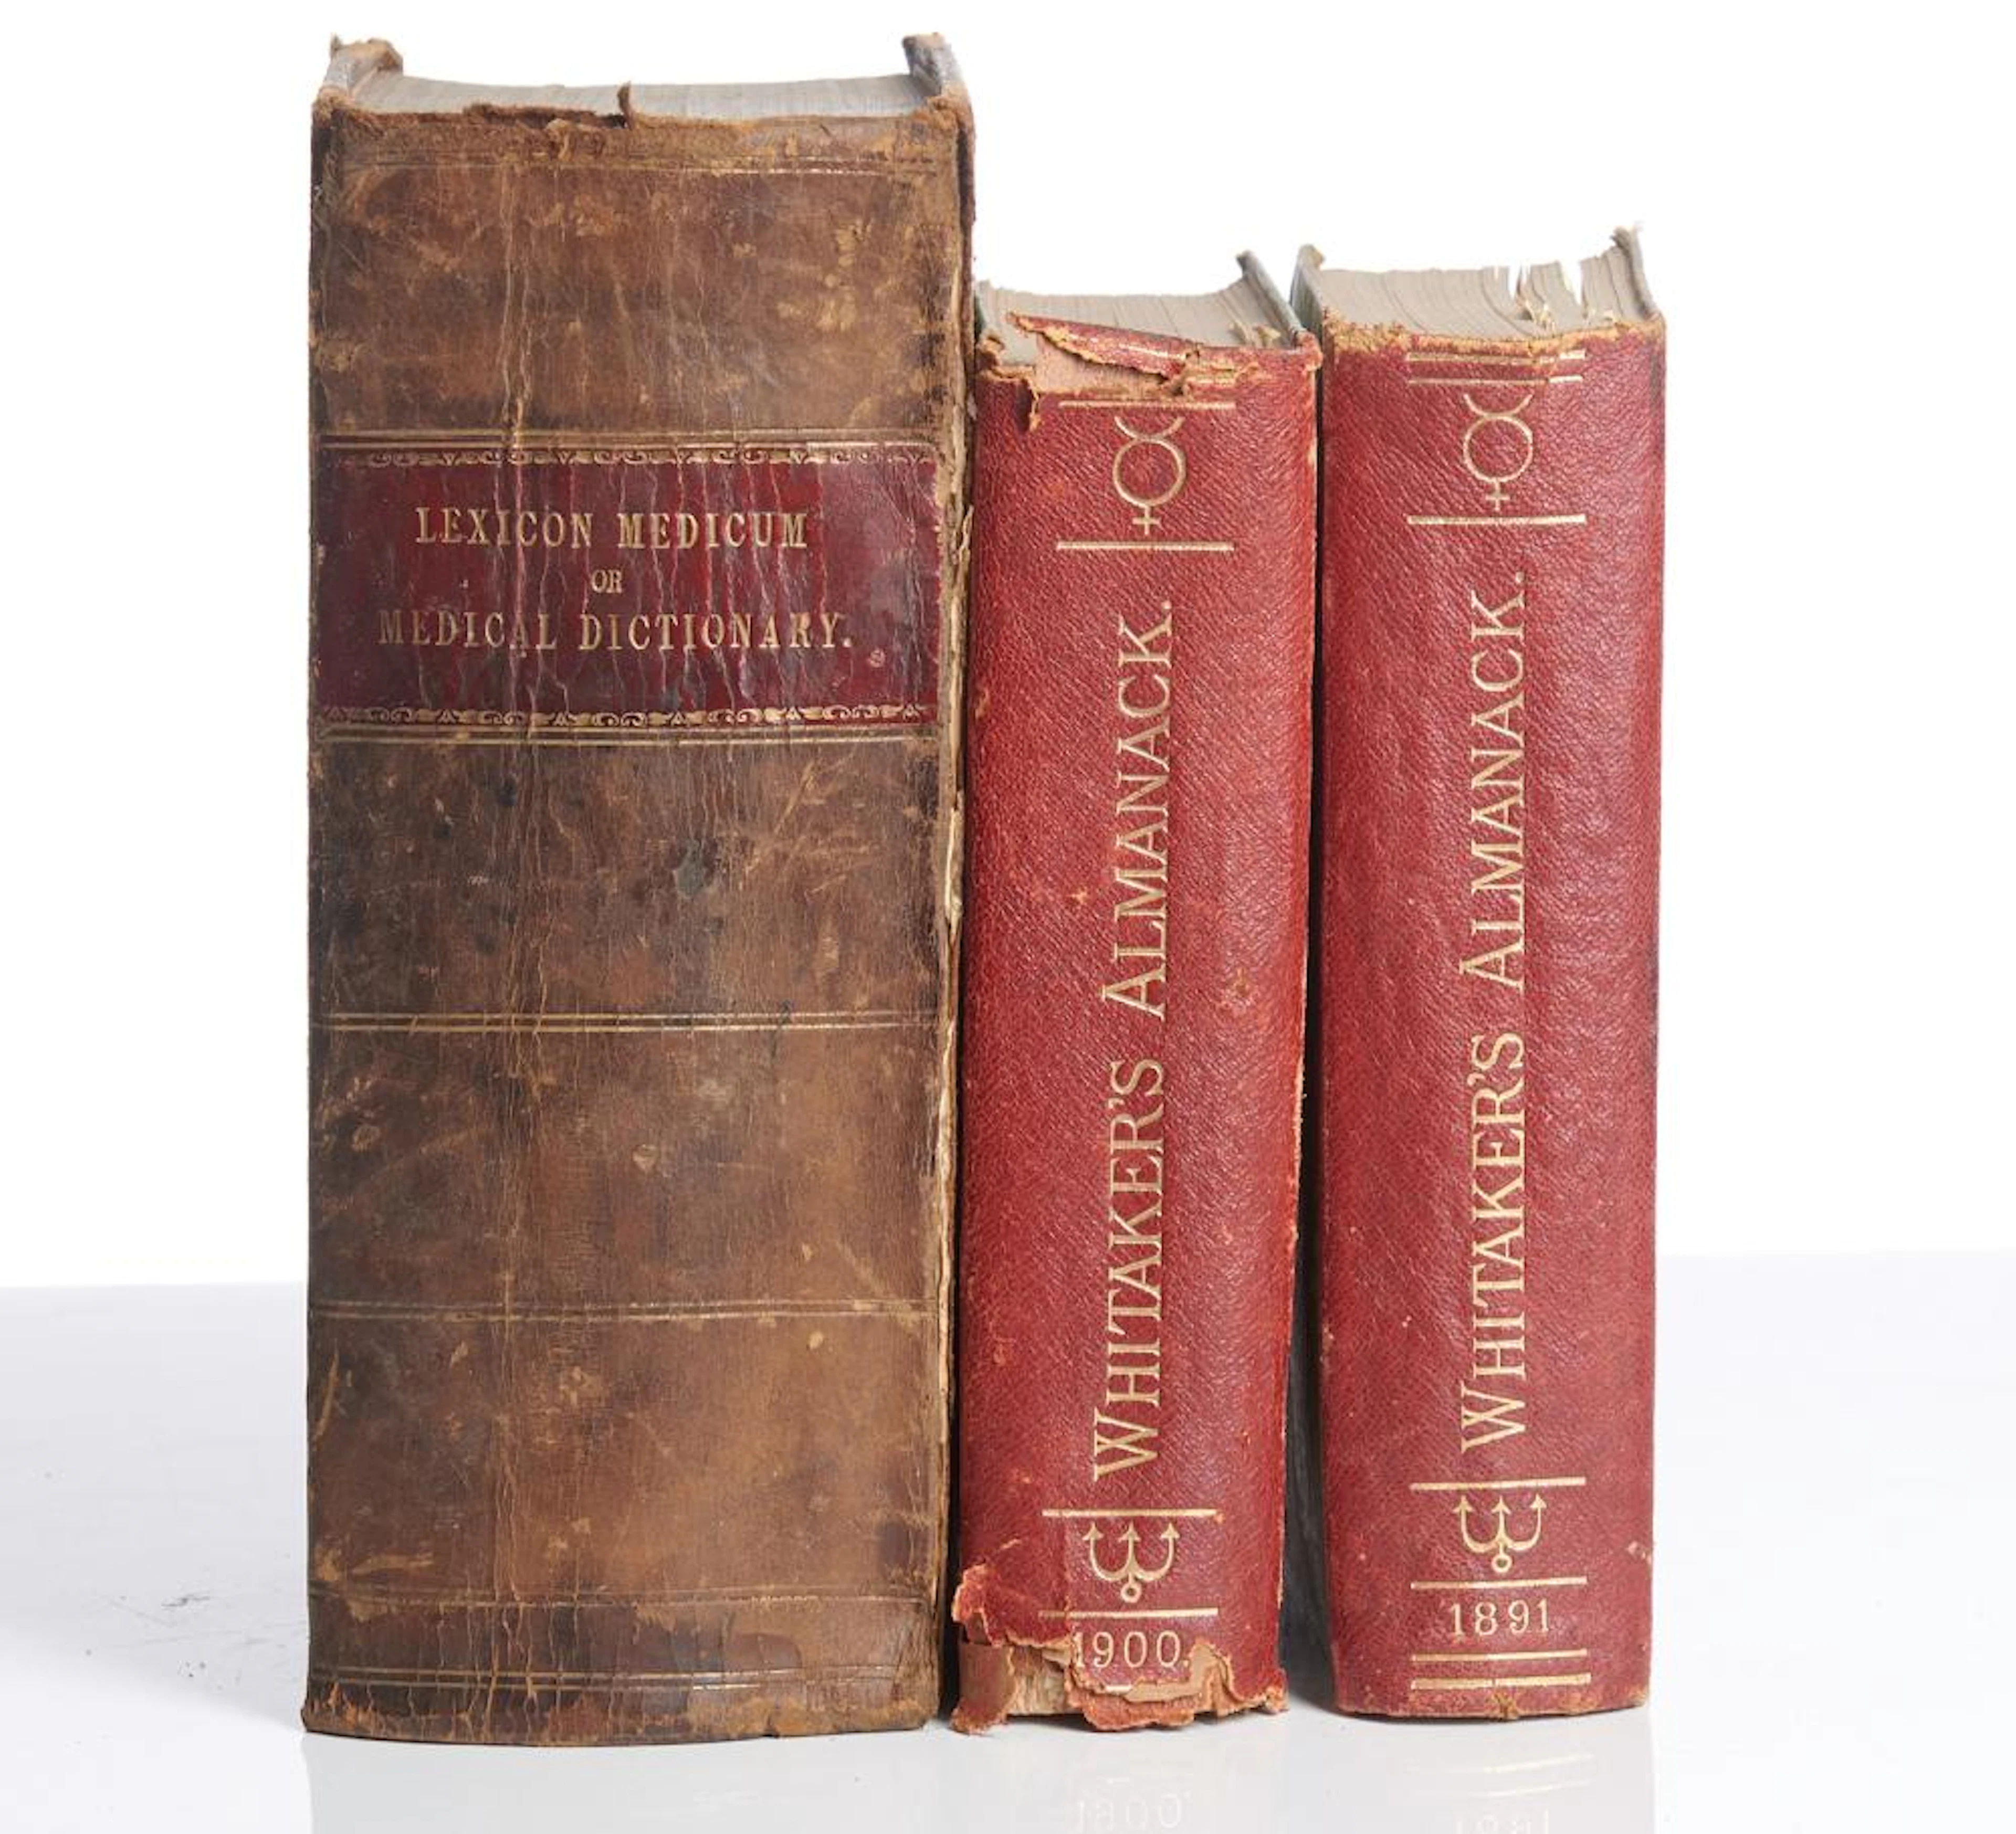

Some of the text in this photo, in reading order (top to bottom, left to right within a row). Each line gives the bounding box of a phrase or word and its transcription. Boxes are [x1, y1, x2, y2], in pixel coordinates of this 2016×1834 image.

[415, 507, 808, 549] LEXICON MEDICUM
[591, 570, 623, 595] OR
[377, 610, 854, 651] MEDICAL DICTIONARY.
[1460, 572, 1526, 1452] WHITAKER'S ALMANACK.
[1094, 600, 1173, 1481] WHITAKER'S ALMANACK.
[1450, 1600, 1552, 1637] 1891
